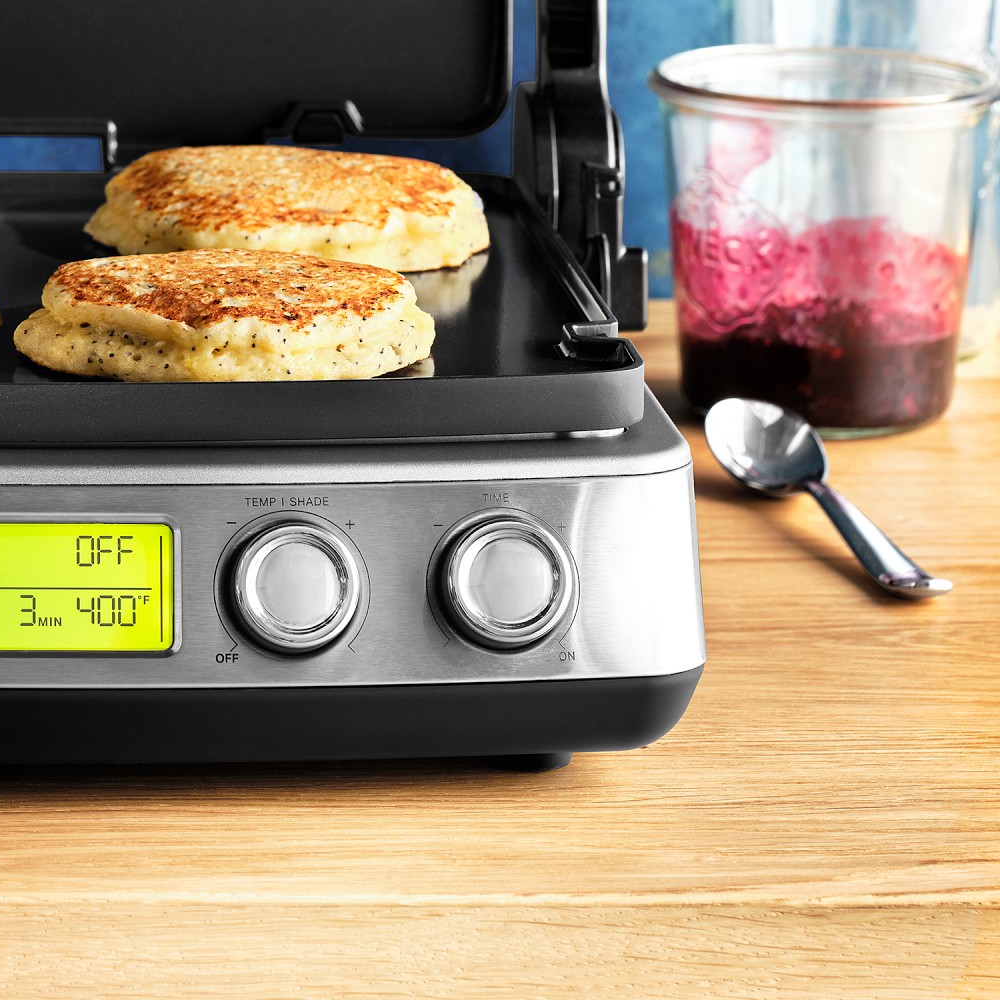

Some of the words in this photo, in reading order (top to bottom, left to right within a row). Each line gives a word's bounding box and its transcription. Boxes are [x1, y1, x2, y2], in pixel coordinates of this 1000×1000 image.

[244, 497, 277, 507] TEMP
[289, 496, 330, 507] SHADE
[482, 492, 510, 503] TIME
[76, 535, 134, 567] OFF
[215, 652, 240, 664] OFF
[558, 651, 576, 662] ON
